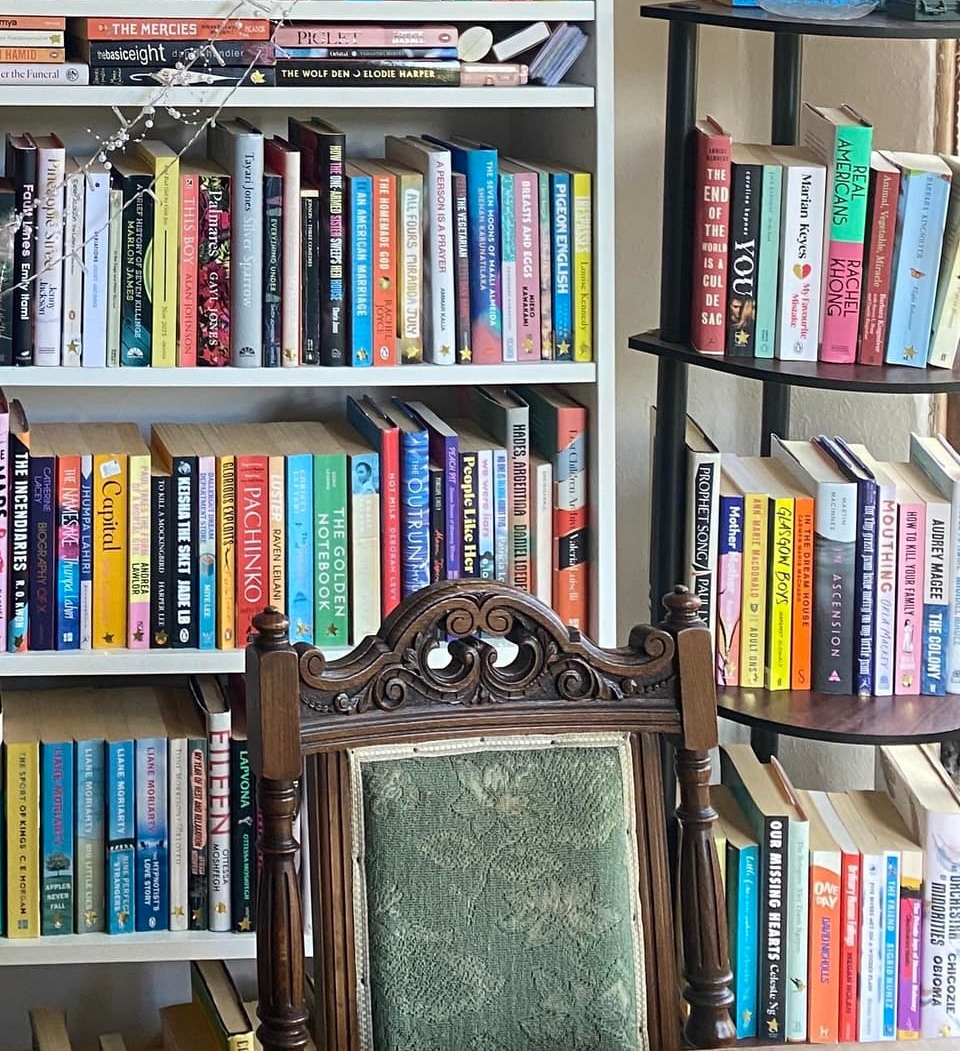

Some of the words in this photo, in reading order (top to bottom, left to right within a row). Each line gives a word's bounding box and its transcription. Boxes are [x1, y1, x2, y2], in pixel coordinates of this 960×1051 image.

[113, 24, 136, 35] THE
[139, 24, 196, 35] MERCIES
[281, 70, 300, 78] THE
[302, 70, 329, 78] WOLF
[332, 70, 350, 78] DEN
[363, 71, 396, 79] ELODIE
[399, 70, 435, 79] HARPER
[704, 186, 728, 202] END
[708, 168, 726, 180] THE
[832, 139, 852, 227] AMERICANS
[852, 165, 867, 200] REAL
[558, 184, 567, 234] PIGEON
[708, 206, 722, 219] OF
[801, 174, 813, 219] Marian
[126, 220, 135, 264] MARLON
[705, 224, 725, 237] THE
[798, 221, 810, 259] Keyes
[125, 267, 133, 301] JAMES
[557, 235, 567, 294] ENGLISH
[703, 274, 723, 287] CUL
[732, 239, 755, 297] YOU
[706, 295, 719, 306] DE
[827, 259, 845, 317] KHONG
[843, 260, 860, 317] RACHEL
[702, 312, 722, 325] SAC
[697, 467, 711, 522] PROPHET
[97, 481, 121, 552] Capital
[332, 507, 344, 538] THE
[728, 506, 741, 548] Mother
[243, 487, 261, 603] PACHINKO
[695, 524, 709, 568] SONG
[931, 519, 945, 560] AUDREY
[318, 513, 329, 611] NOTEBOOK
[332, 545, 344, 616] GOLDEN
[930, 563, 943, 600] MAGEE
[931, 613, 943, 634] THE
[926, 637, 942, 681] COLONY
[769, 820, 782, 849] OUR
[769, 853, 782, 908] MISSING
[767, 912, 781, 962] HEARTS
[932, 956, 944, 1006] OBIOMA
